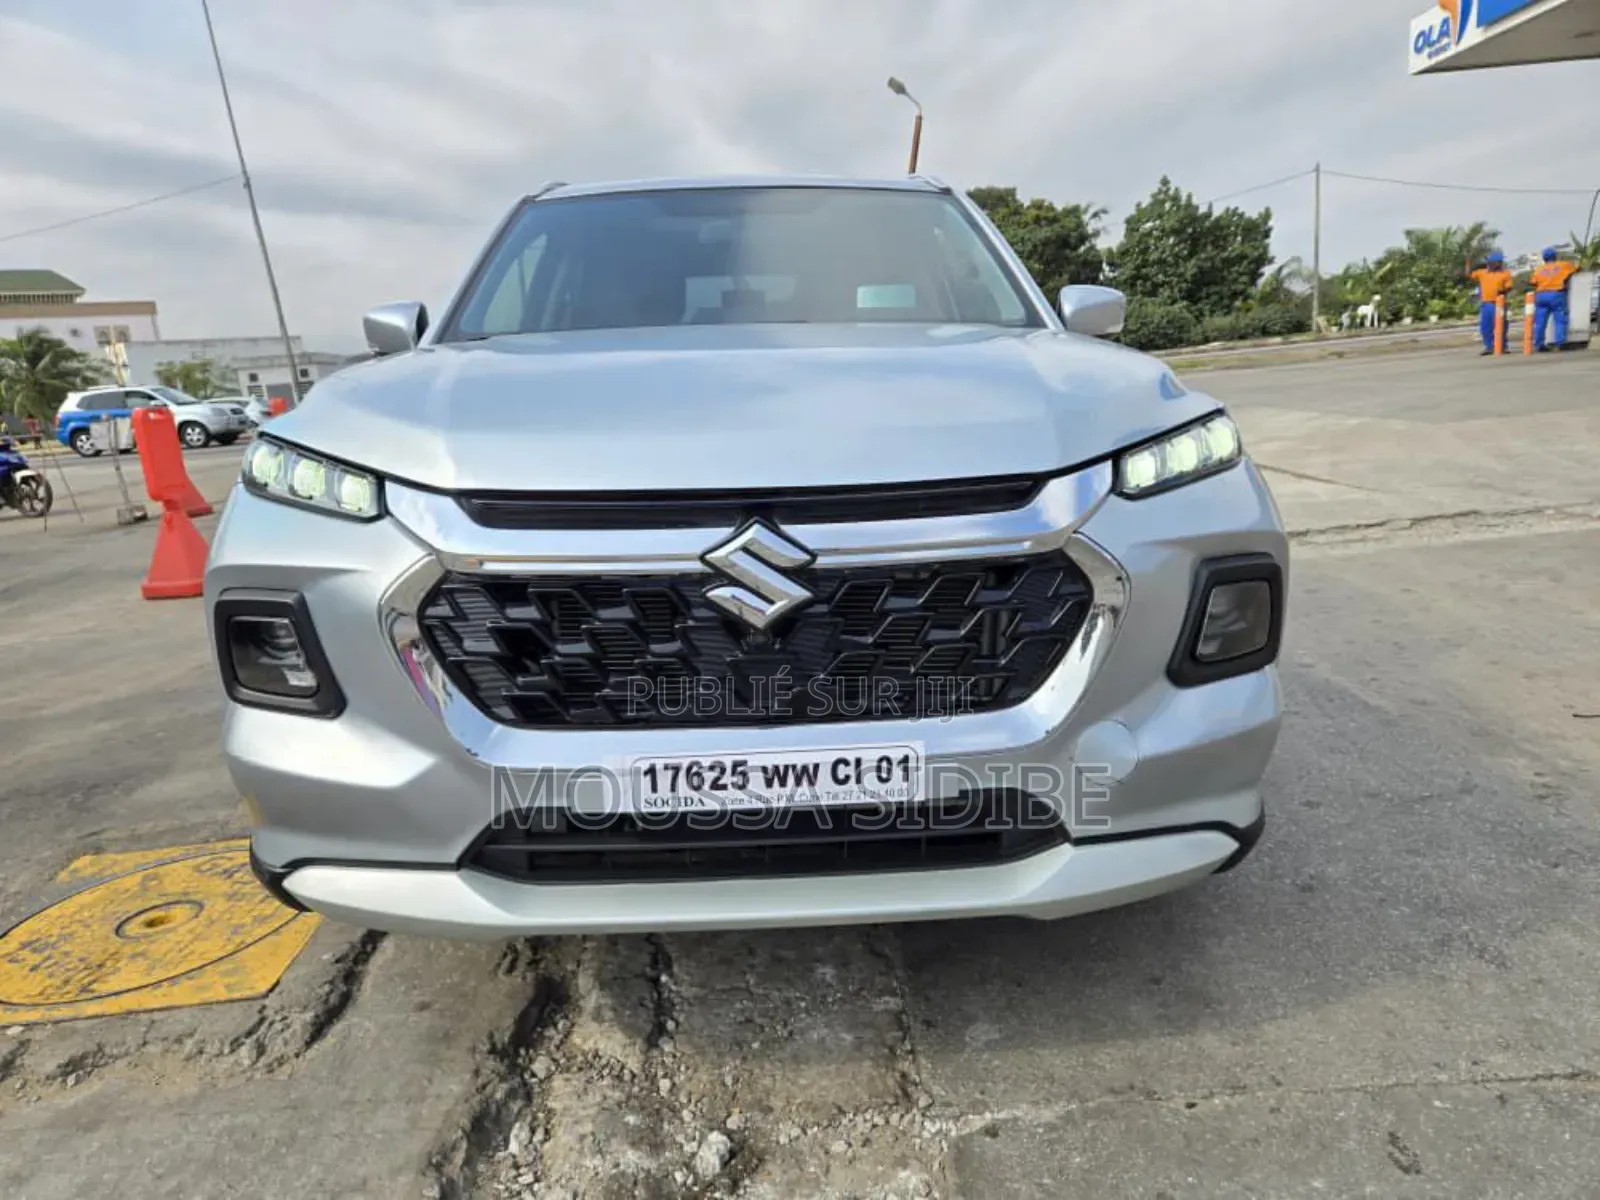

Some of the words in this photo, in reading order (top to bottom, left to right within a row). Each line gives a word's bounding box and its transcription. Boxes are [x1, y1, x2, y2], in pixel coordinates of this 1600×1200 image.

[1413, 17, 1450, 54] OLA
[643, 759, 750, 793] 17625
[831, 757, 862, 786] CI
[876, 754, 910, 784] 01
[644, 795, 706, 809] SOCIDA
